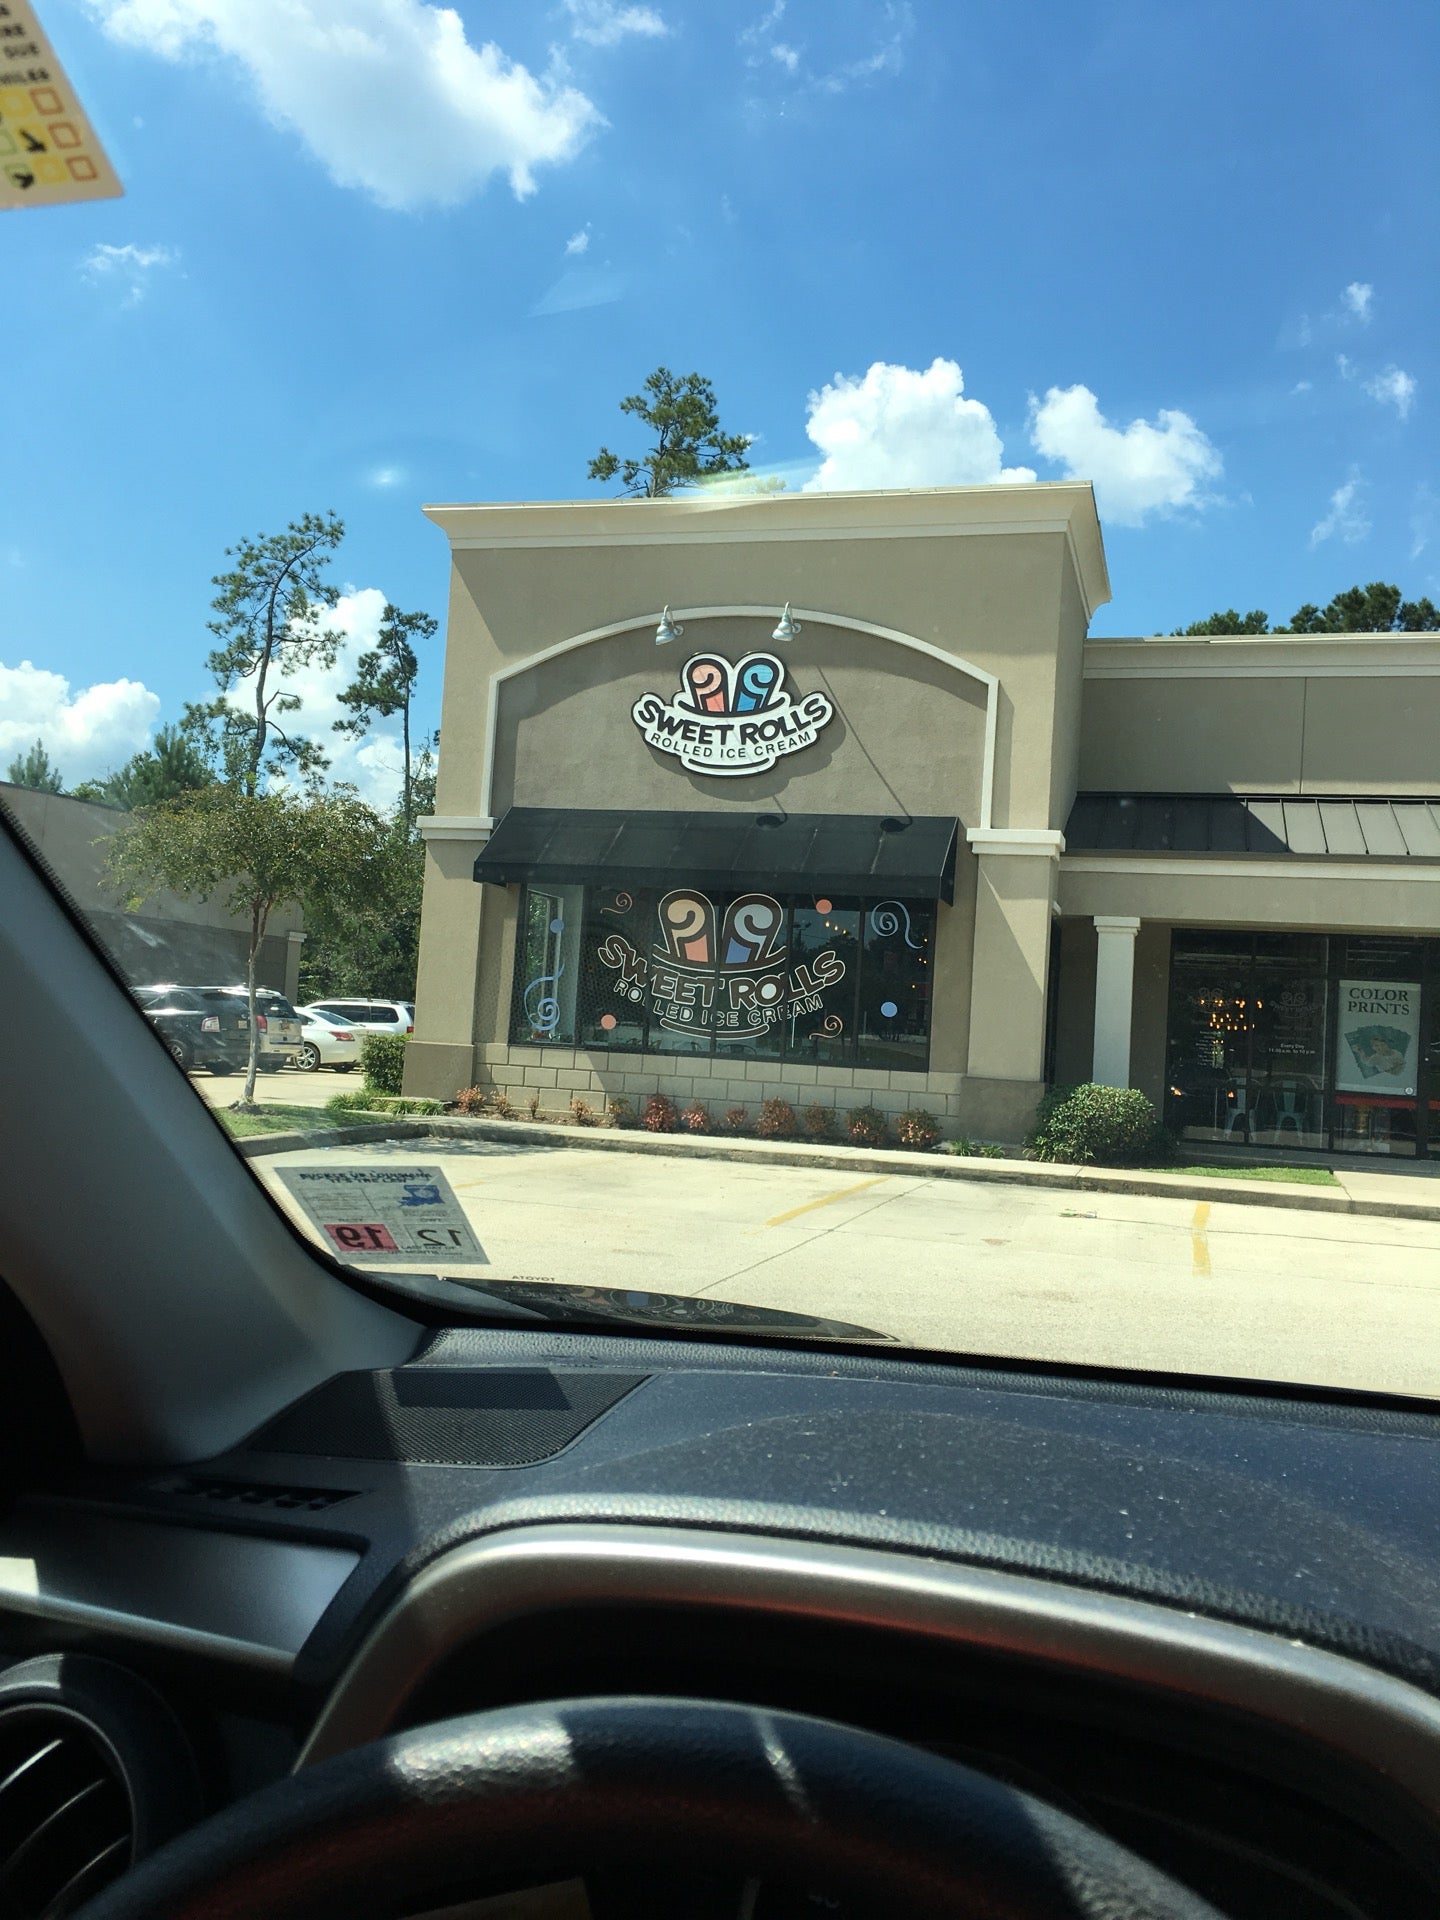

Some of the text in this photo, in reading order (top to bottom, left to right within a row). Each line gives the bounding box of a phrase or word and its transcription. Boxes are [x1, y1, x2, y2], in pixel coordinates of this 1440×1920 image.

[638, 698, 827, 746] SWEET ROLLS
[650, 731, 811, 758] ROLLED ICE CREAM
[598, 935, 846, 1011] SWEET ROLLS
[1348, 987, 1409, 1002] COLOR
[1347, 1001, 1411, 1016] PRINTS
